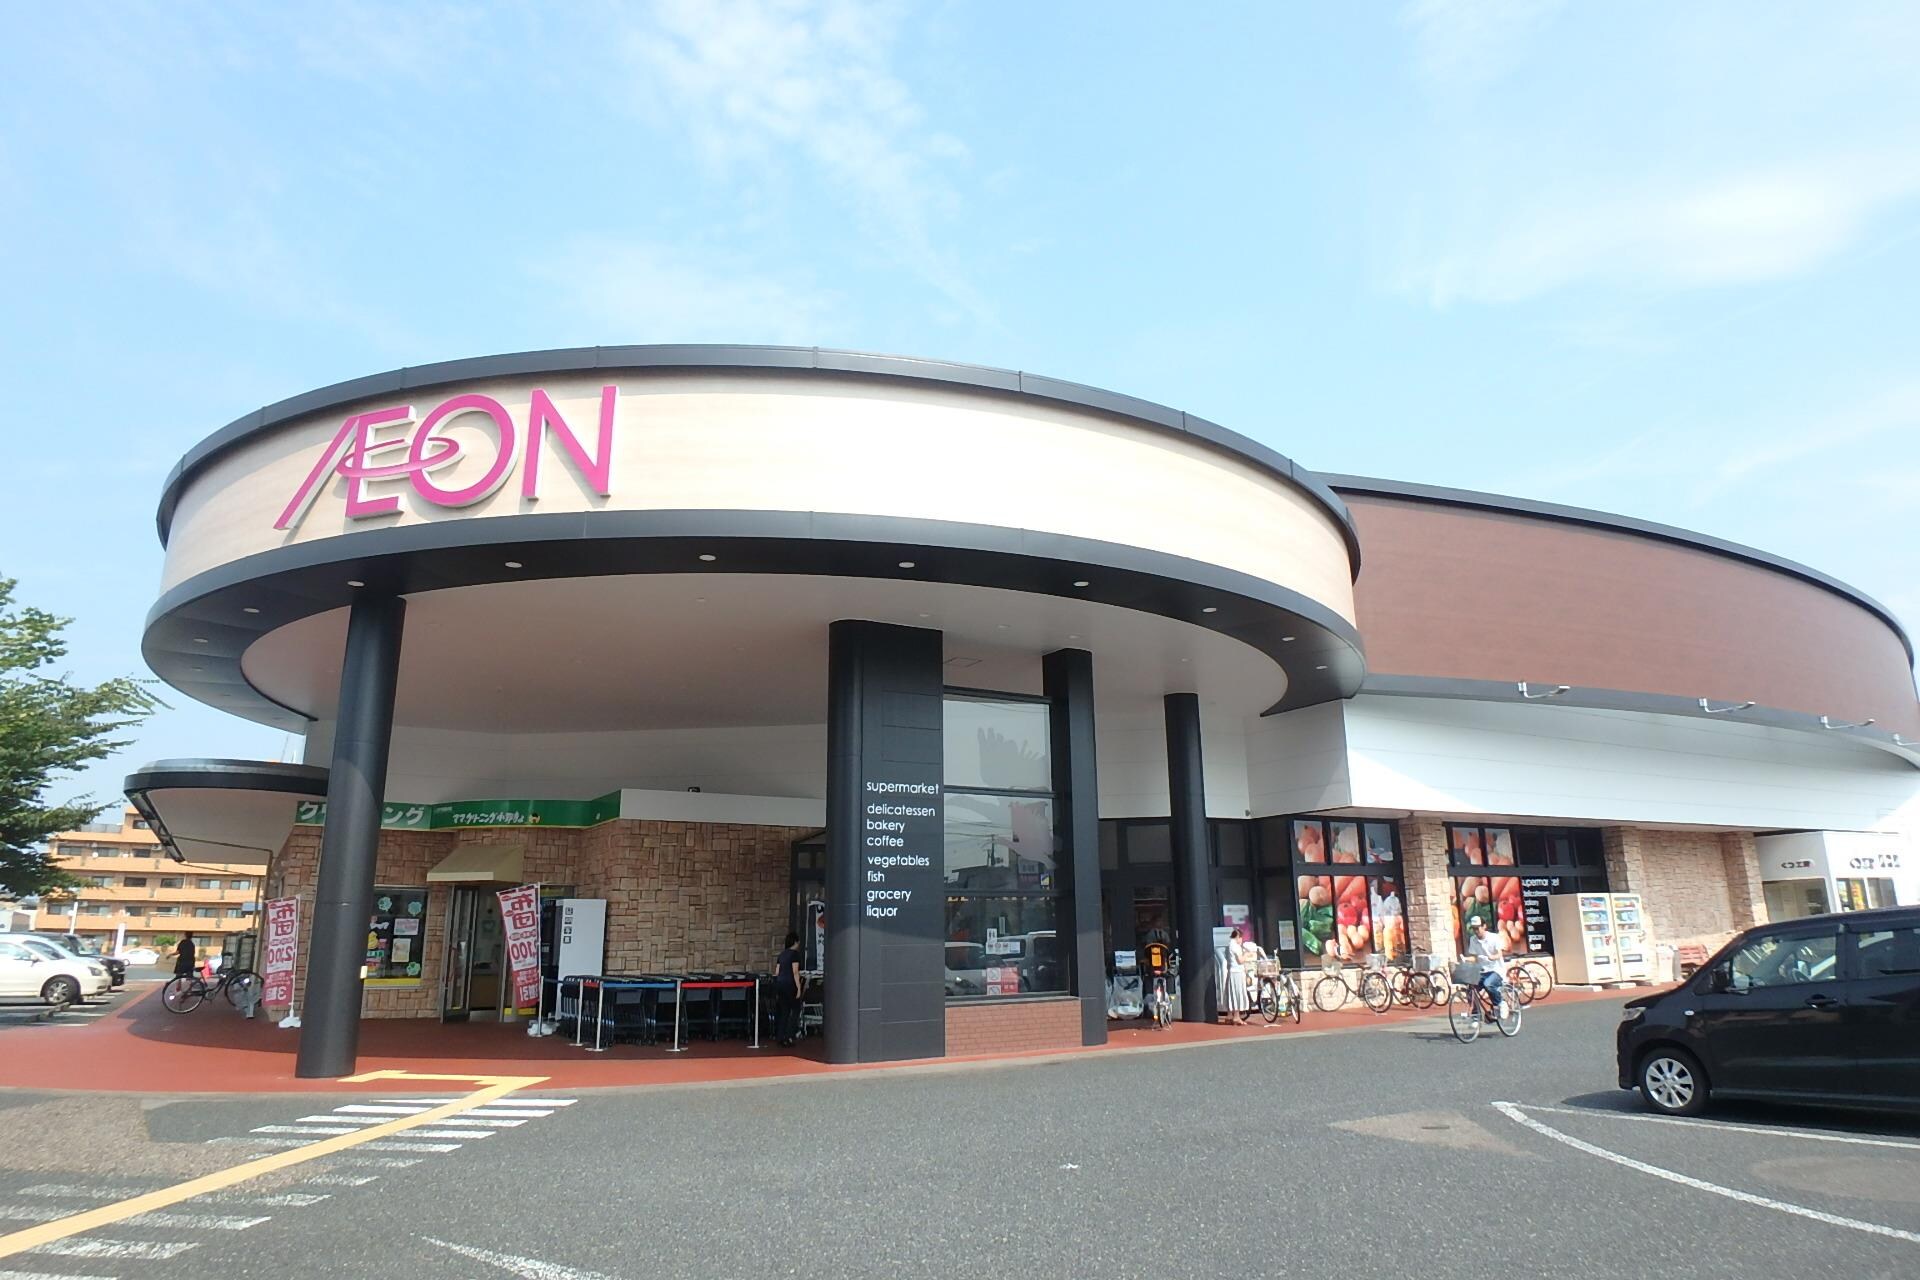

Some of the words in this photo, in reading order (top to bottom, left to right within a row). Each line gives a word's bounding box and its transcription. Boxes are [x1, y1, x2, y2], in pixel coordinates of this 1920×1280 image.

[866, 782, 939, 795] supermarket
[867, 803, 936, 817] delicatessen
[866, 819, 905, 833] bakery
[866, 835, 904, 847] coffee
[867, 855, 930, 868] vegetables
[867, 870, 885, 882] fish
[866, 890, 912, 902] grocery
[866, 905, 898, 918] liquor
